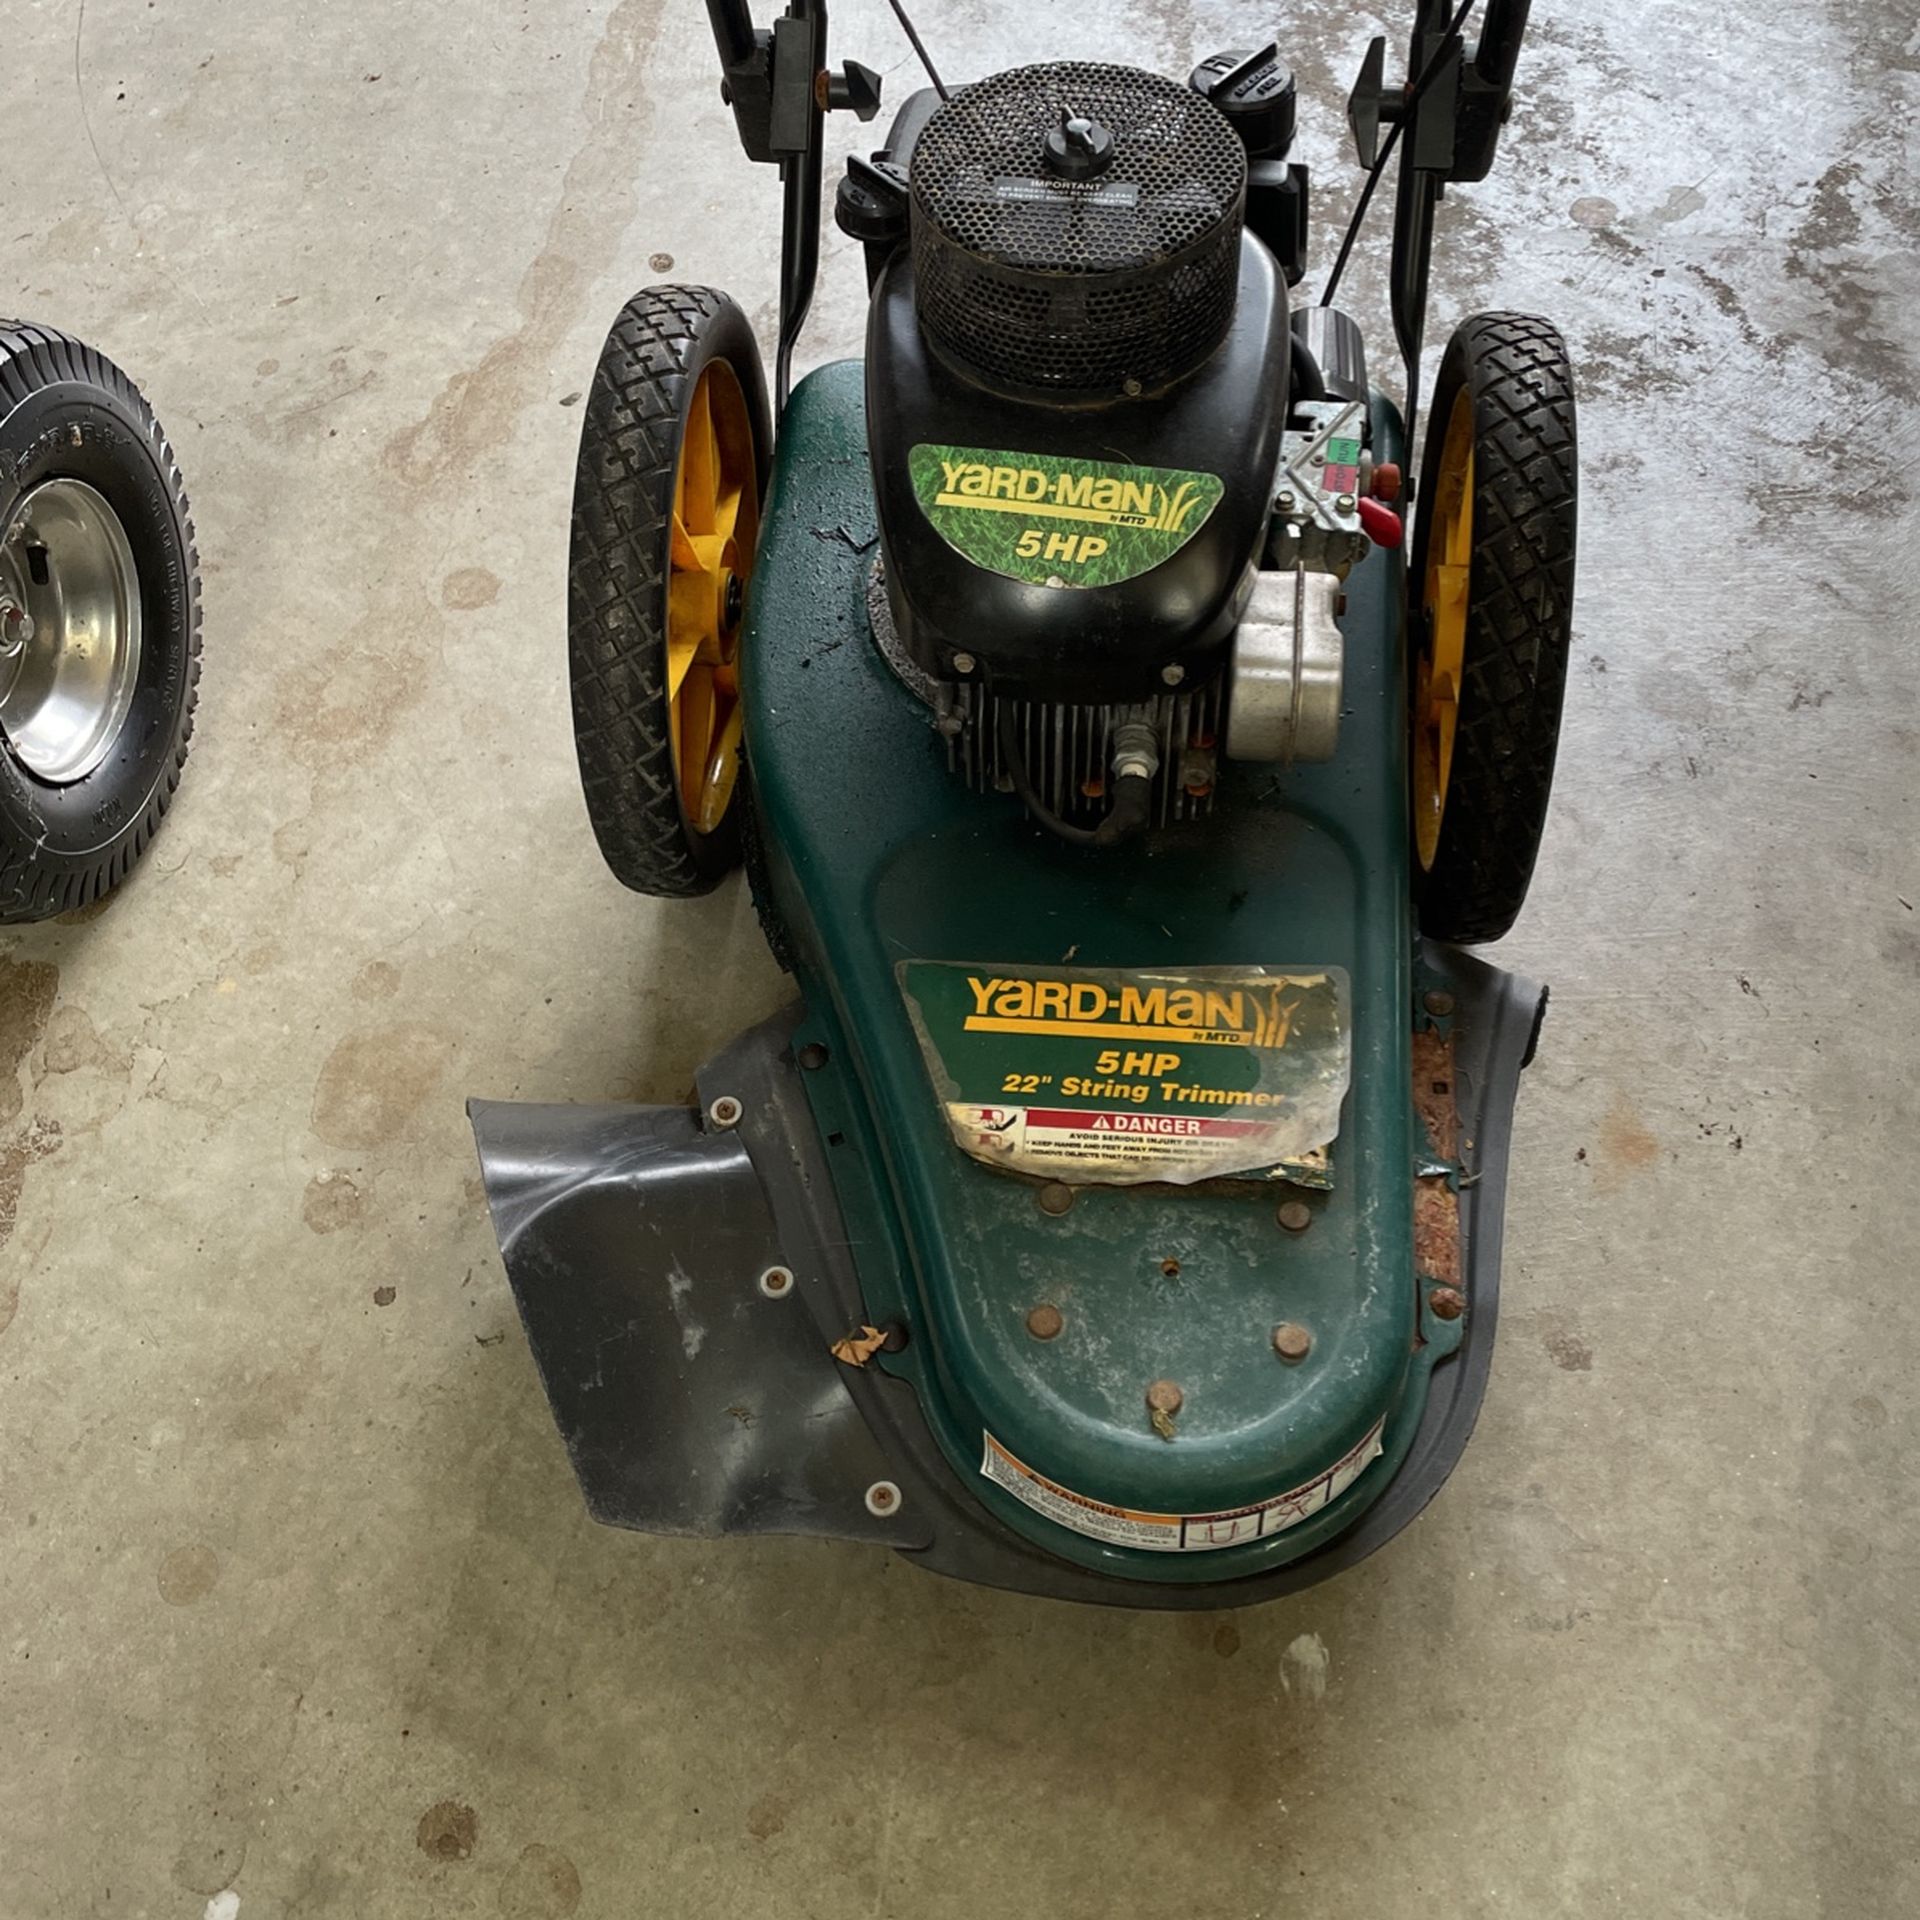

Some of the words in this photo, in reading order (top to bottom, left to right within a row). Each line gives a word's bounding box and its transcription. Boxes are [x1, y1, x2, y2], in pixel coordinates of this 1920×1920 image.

[1031, 180, 1102, 191] IMPORTANT
[1338, 442, 1350, 462] RUN
[1119, 515, 1147, 526] MTD
[1204, 1031, 1240, 1044] MTD
[1001, 1073, 1053, 1094] 22"
[1060, 1076, 1150, 1103] String
[1160, 1082, 1286, 1108] Trimmer
[1113, 1116, 1201, 1135] DANGER
[1069, 1132, 1100, 1141] AVOID
[1102, 1134, 1144, 1143] SERIOUS
[1146, 1137, 1182, 1146] INJURY
[1048, 1484, 1127, 1519] WARNING
